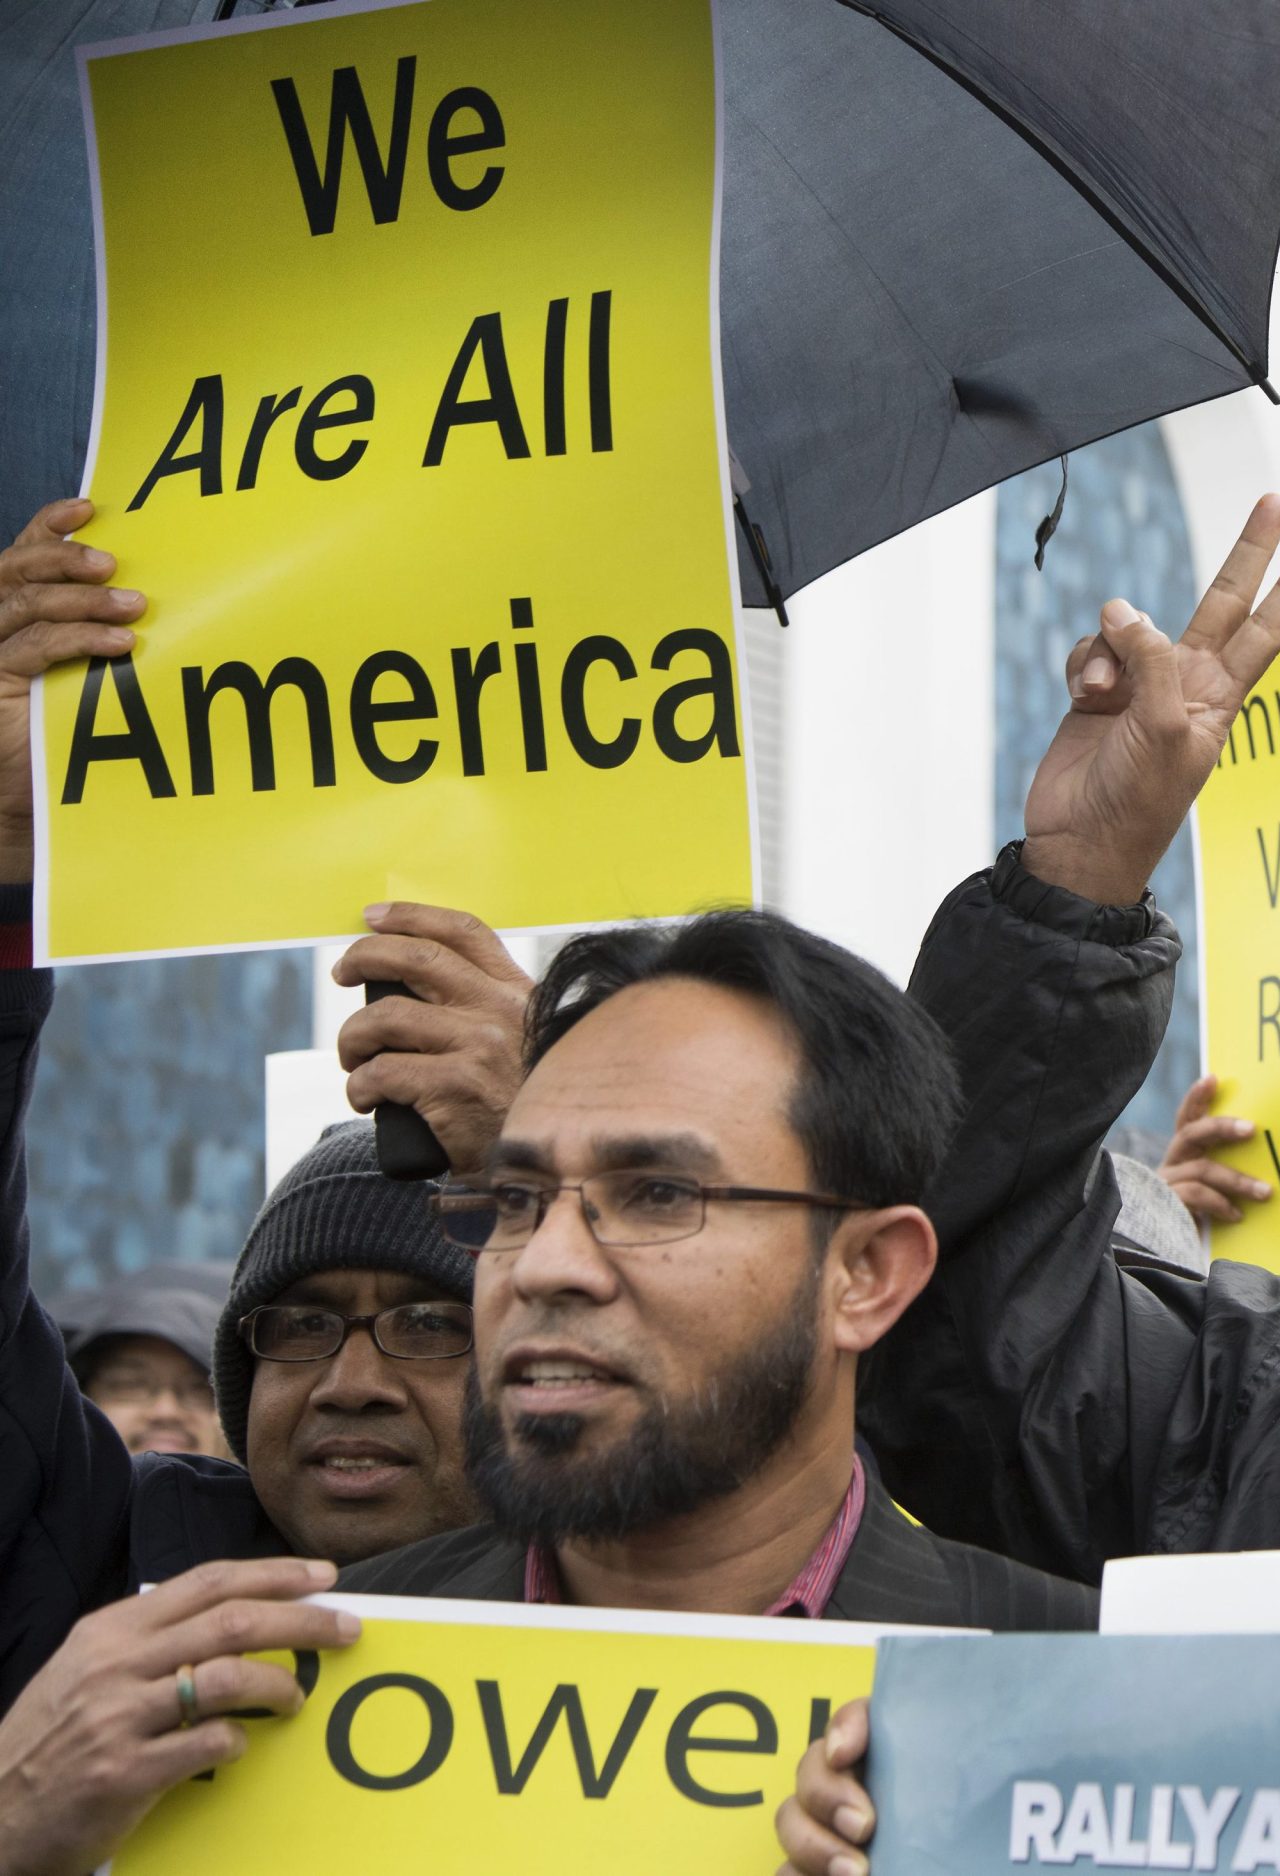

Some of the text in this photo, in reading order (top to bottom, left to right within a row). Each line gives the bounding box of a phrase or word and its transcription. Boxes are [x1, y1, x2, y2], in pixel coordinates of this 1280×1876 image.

[268, 54, 507, 237] We
[125, 289, 614, 513] Are All
[60, 597, 742, 806] America
[1008, 1779, 1242, 1872] RALLY
